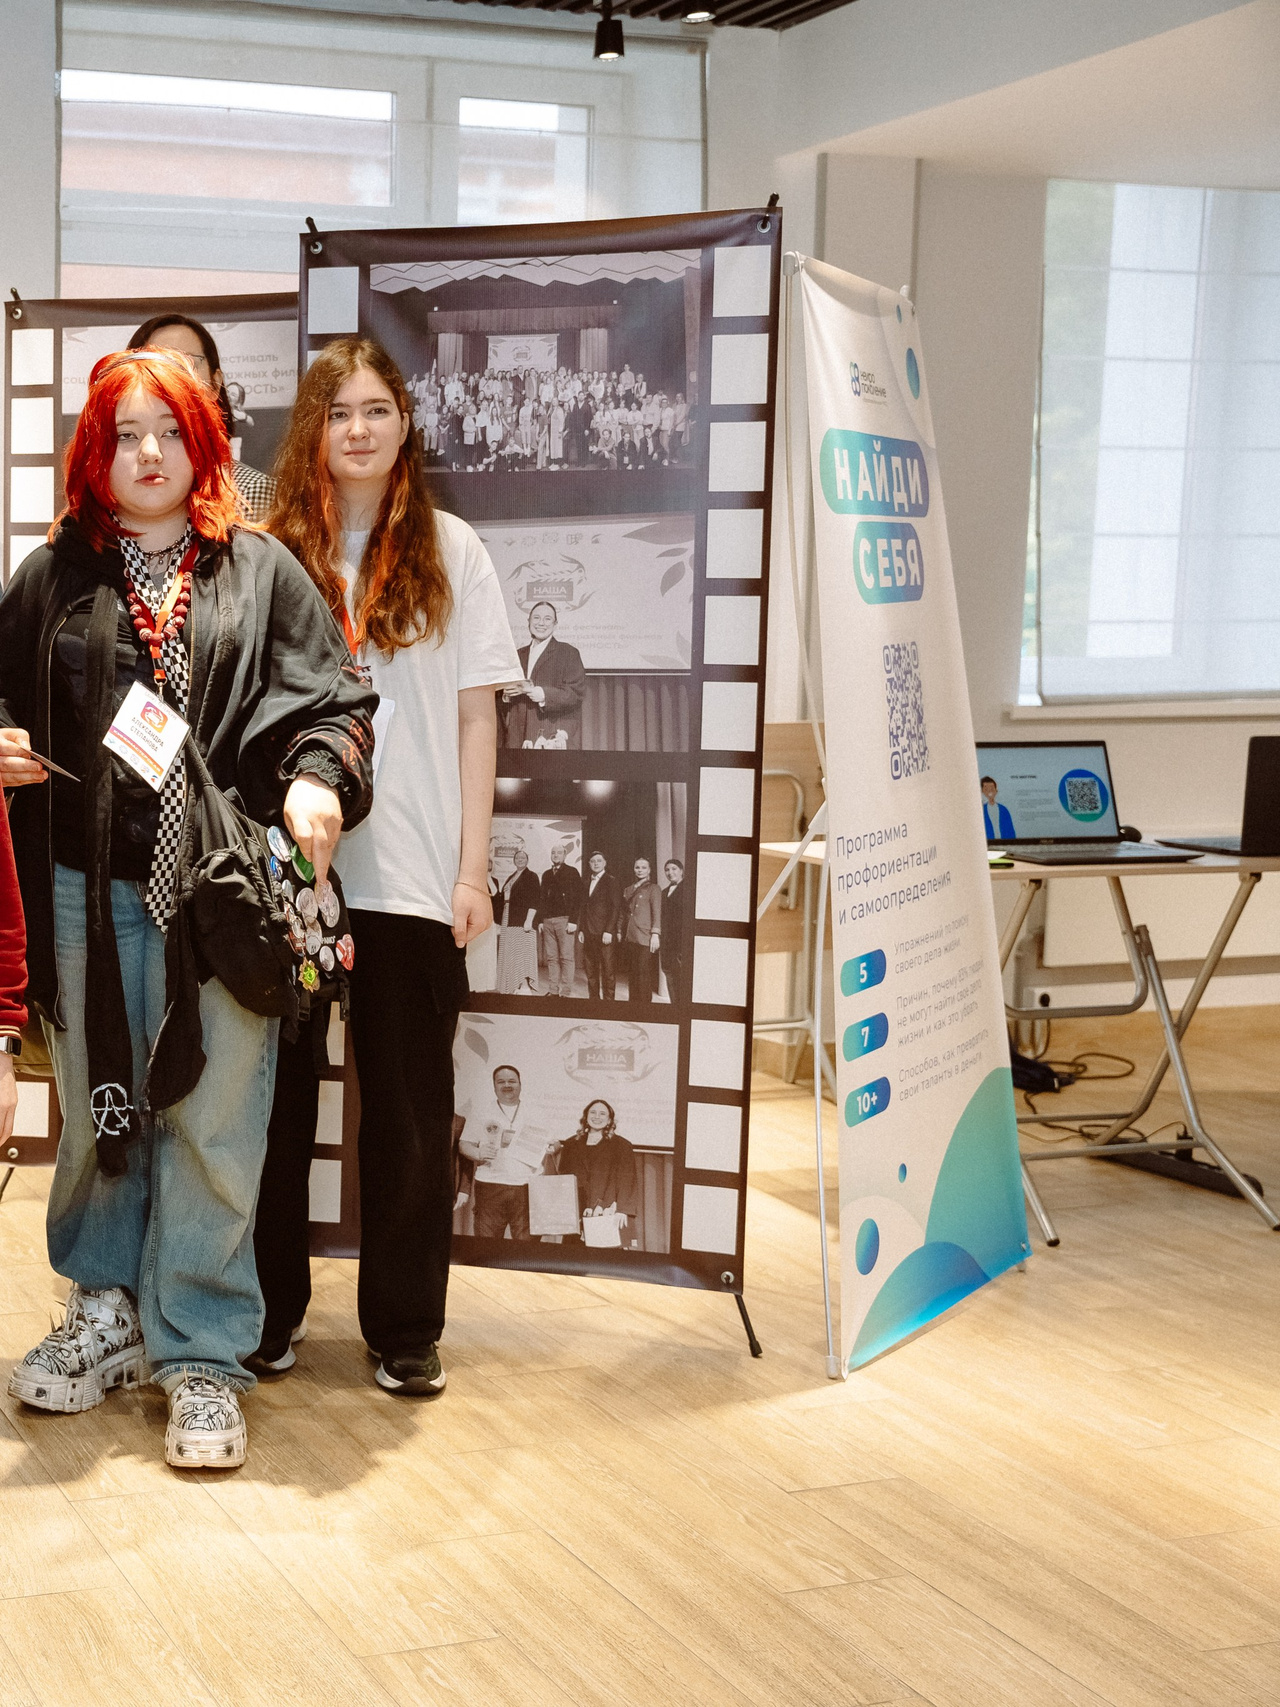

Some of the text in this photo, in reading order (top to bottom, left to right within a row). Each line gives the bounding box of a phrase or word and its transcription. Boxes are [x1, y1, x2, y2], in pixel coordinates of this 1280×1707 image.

[220, 354, 278, 363] естиваль
[833, 440, 923, 513] НАЙДИ
[859, 538, 921, 589] СЕБЯ
[533, 586, 567, 595] НАША
[129, 725, 159, 752] СТЕПАНОВА
[131, 716, 165, 747] АЛЕКСАНДРА
[836, 823, 908, 860] Программа
[837, 845, 938, 894] профориентации
[839, 871, 952, 926] и самоопределения
[894, 925, 944, 956] Упражнений
[859, 962, 868, 984] 5
[895, 955, 922, 974] своего
[924, 947, 942, 965] дела
[896, 989, 930, 1011] Причин,
[932, 975, 958, 995] почему
[897, 1016, 907, 1029] не
[909, 1005, 932, 1022] могут
[934, 995, 956, 1013] найти
[861, 1026, 869, 1048] 7
[897, 1028, 924, 1048] жизни
[926, 1025, 932, 1035] и
[933, 1020, 947, 1032] как
[948, 1012, 959, 1026] это
[898, 1056, 940, 1083] Способов,
[942, 1048, 955, 1062] как
[899, 1084, 919, 1101] свои
[921, 1068, 953, 1091] таланты
[856, 1091, 878, 1116] 10+
